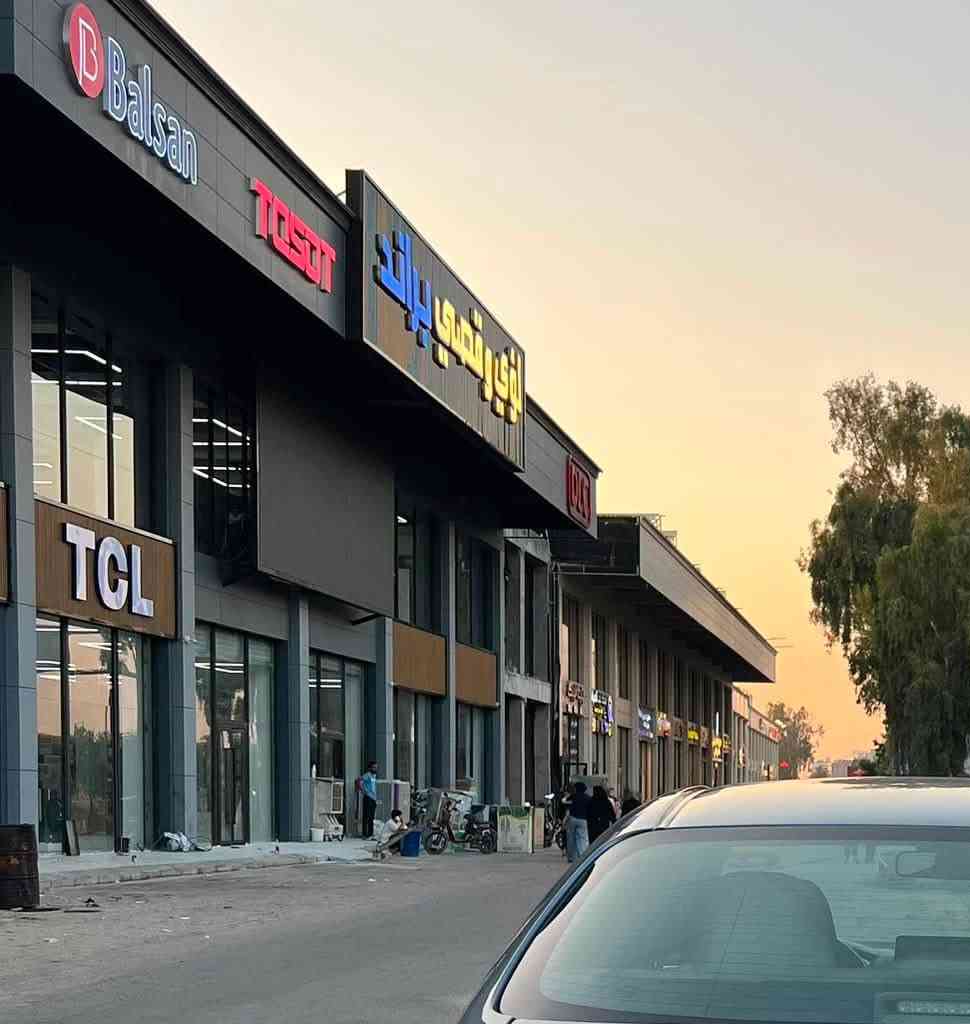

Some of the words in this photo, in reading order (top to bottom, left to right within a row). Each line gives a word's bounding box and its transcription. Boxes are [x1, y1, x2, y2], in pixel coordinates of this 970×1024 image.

[106, 36, 198, 185] Balsan
[254, 178, 336, 294] TOSOT
[64, 522, 154, 617] TCL
